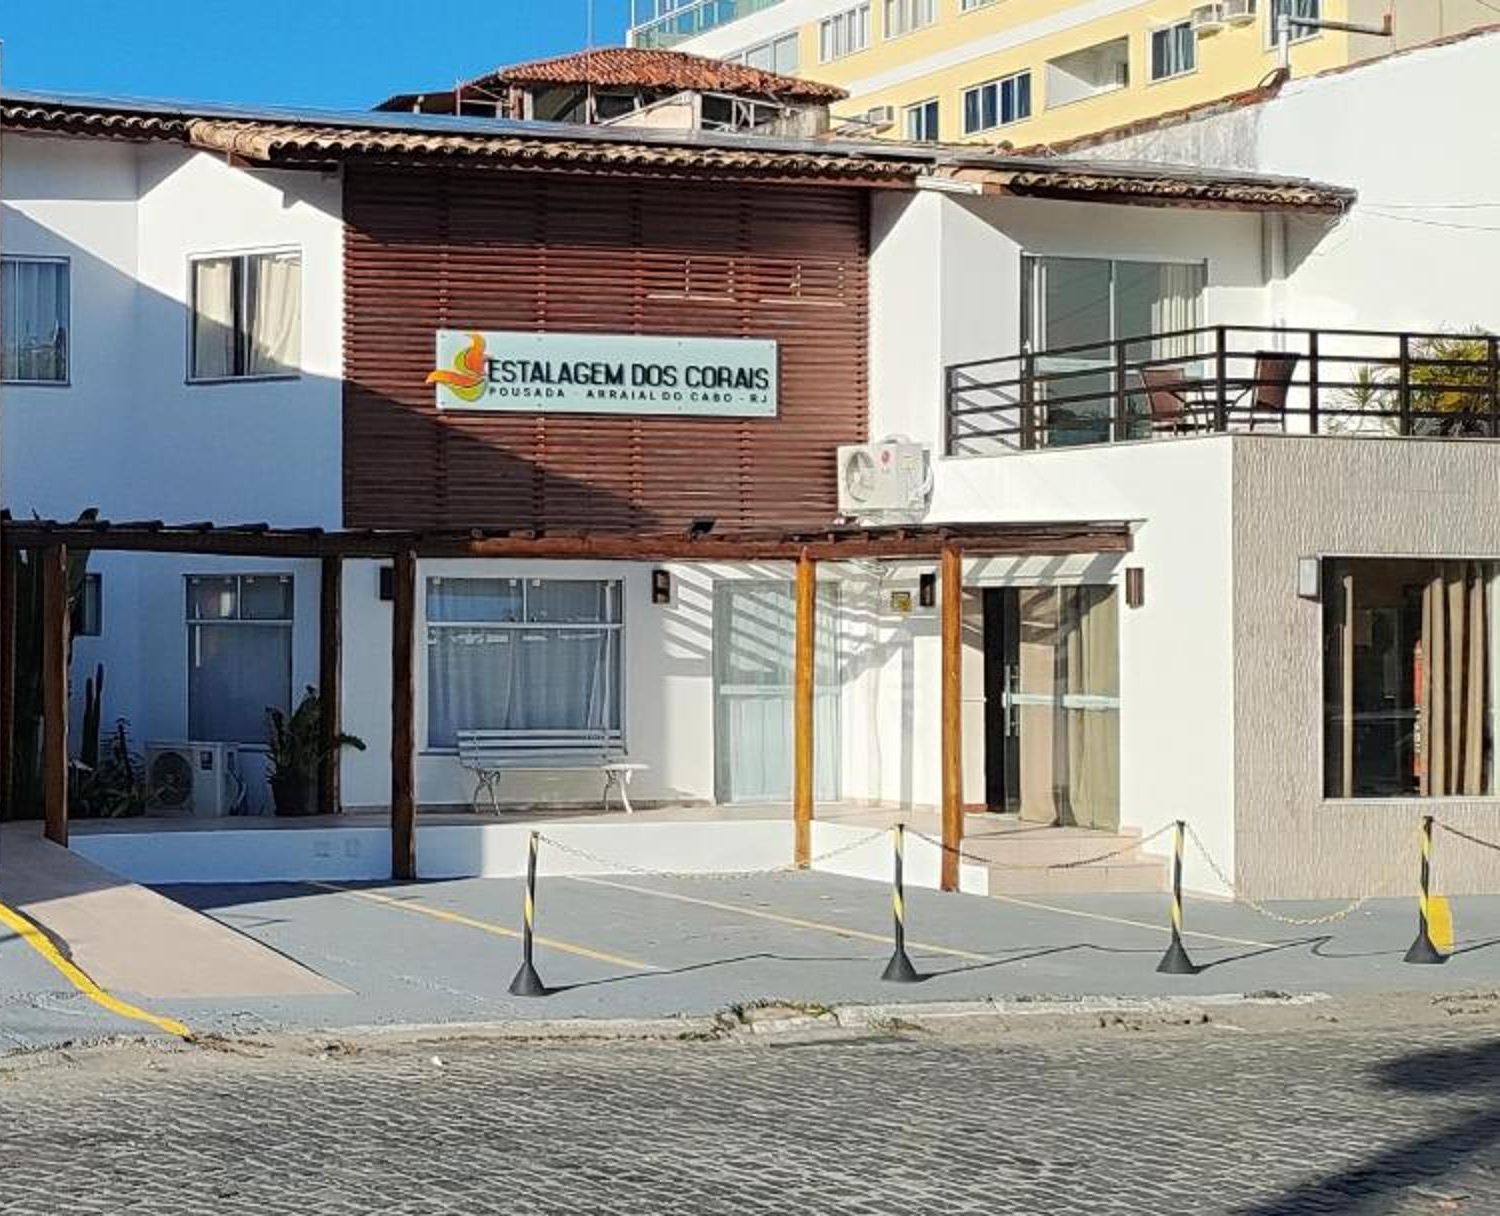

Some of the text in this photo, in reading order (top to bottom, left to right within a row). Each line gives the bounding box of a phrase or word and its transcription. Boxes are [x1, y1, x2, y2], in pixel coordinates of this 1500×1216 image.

[487, 358, 769, 390] ESTALAGEM DOS CORAIS
[489, 386, 565, 399] POUSADA
[586, 389, 656, 401] ARRAIAL
[662, 391, 682, 401] DO
[690, 391, 732, 403] CABO
[749, 393, 767, 403] RJ
